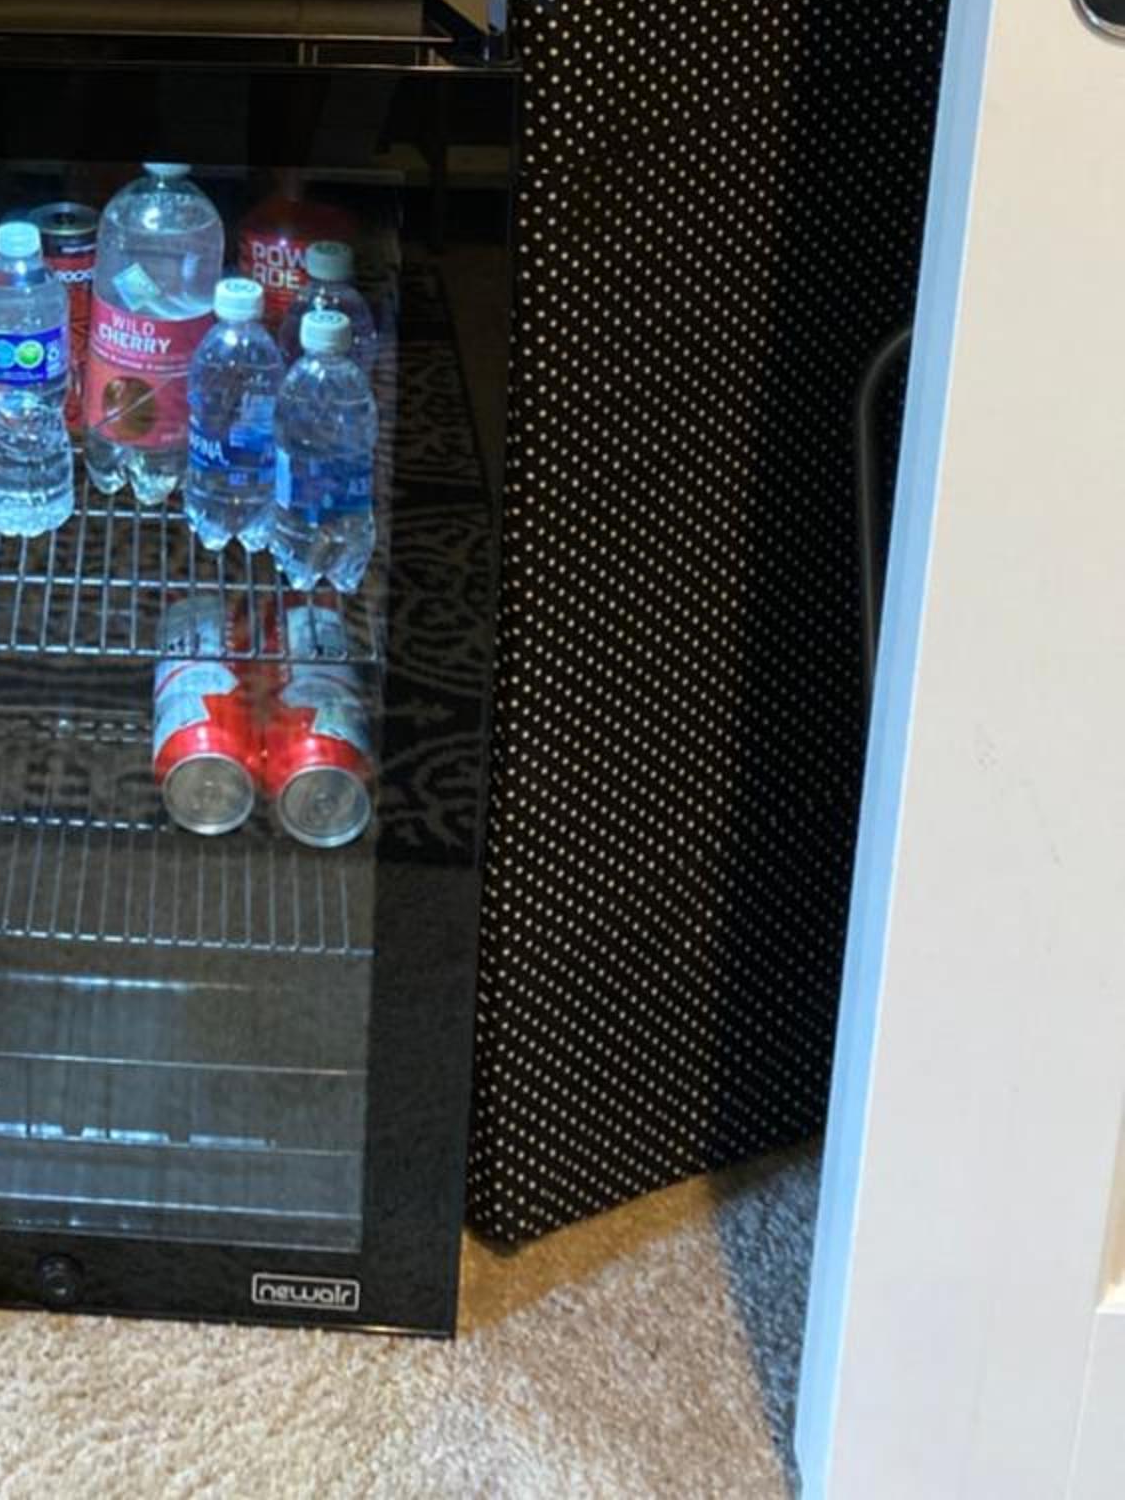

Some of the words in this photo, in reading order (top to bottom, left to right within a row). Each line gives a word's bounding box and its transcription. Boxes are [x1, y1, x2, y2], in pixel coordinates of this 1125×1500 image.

[252, 241, 308, 269] POW
[110, 312, 155, 338] WILD
[97, 323, 172, 355] CHERRY
[258, 1284, 352, 1306] newair
